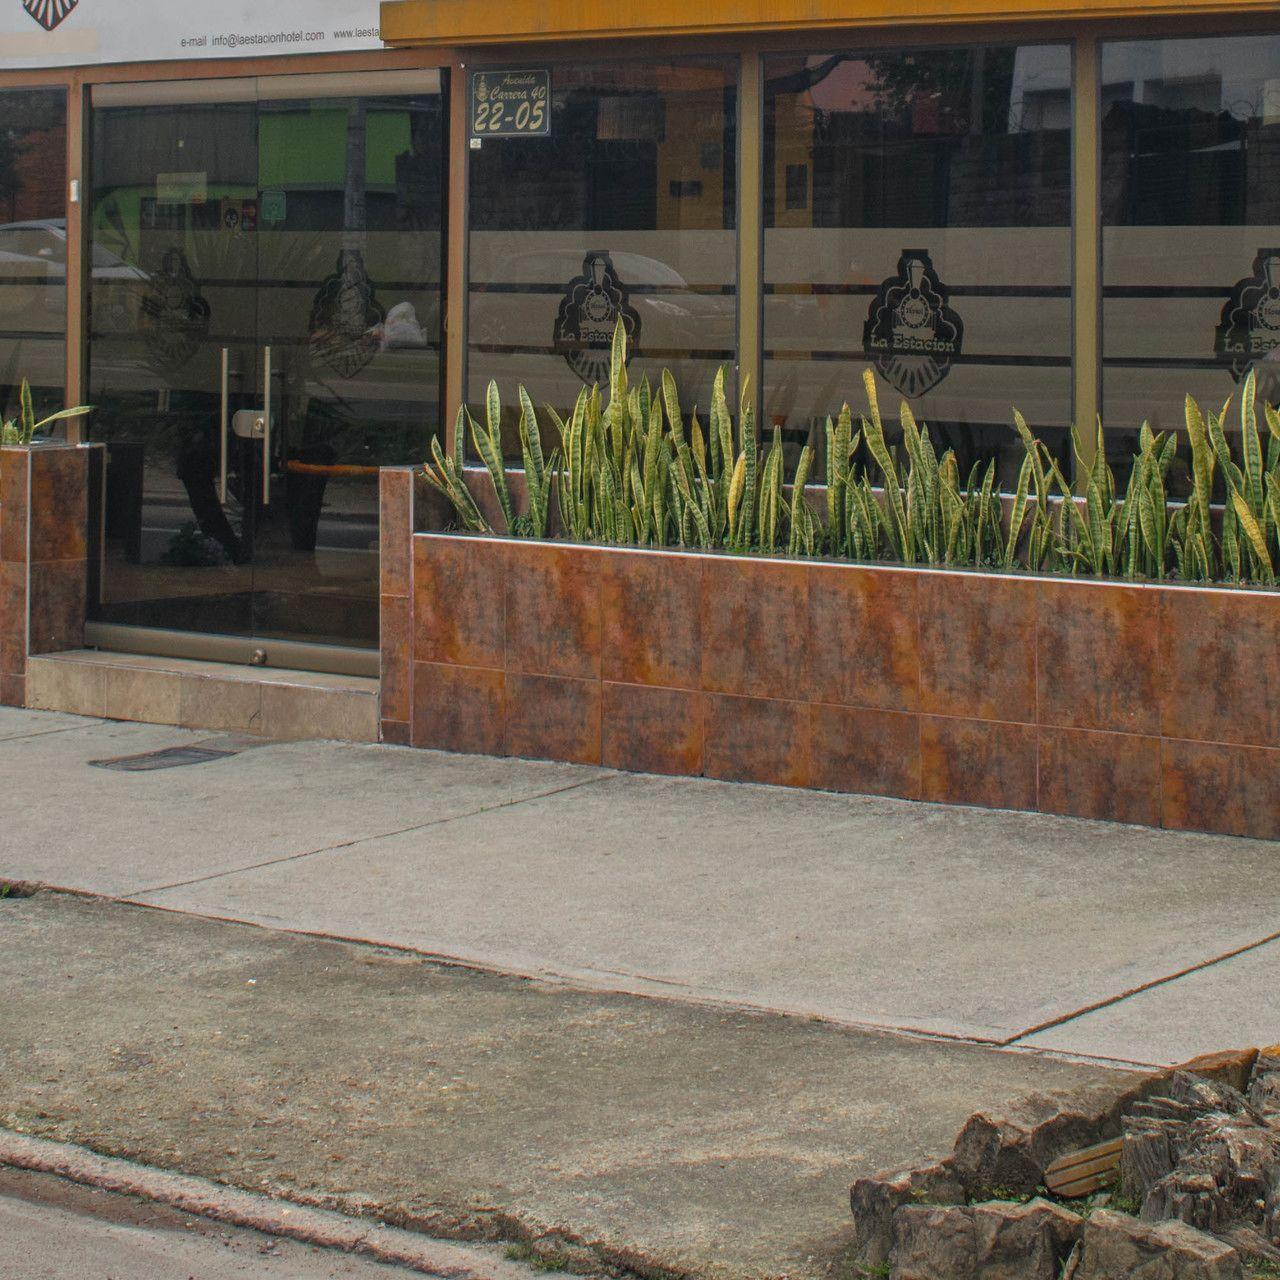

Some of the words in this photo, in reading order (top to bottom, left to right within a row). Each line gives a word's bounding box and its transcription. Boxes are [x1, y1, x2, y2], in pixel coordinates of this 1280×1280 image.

[181, 36, 207, 48] e-mail
[212, 30, 325, 49] info@laestacionhotel.com
[490, 86, 527, 100] Carrera
[531, 86, 546, 100] 40
[475, 100, 546, 131] 22-05
[870, 334, 887, 348] La
[1224, 338, 1245, 353] La
